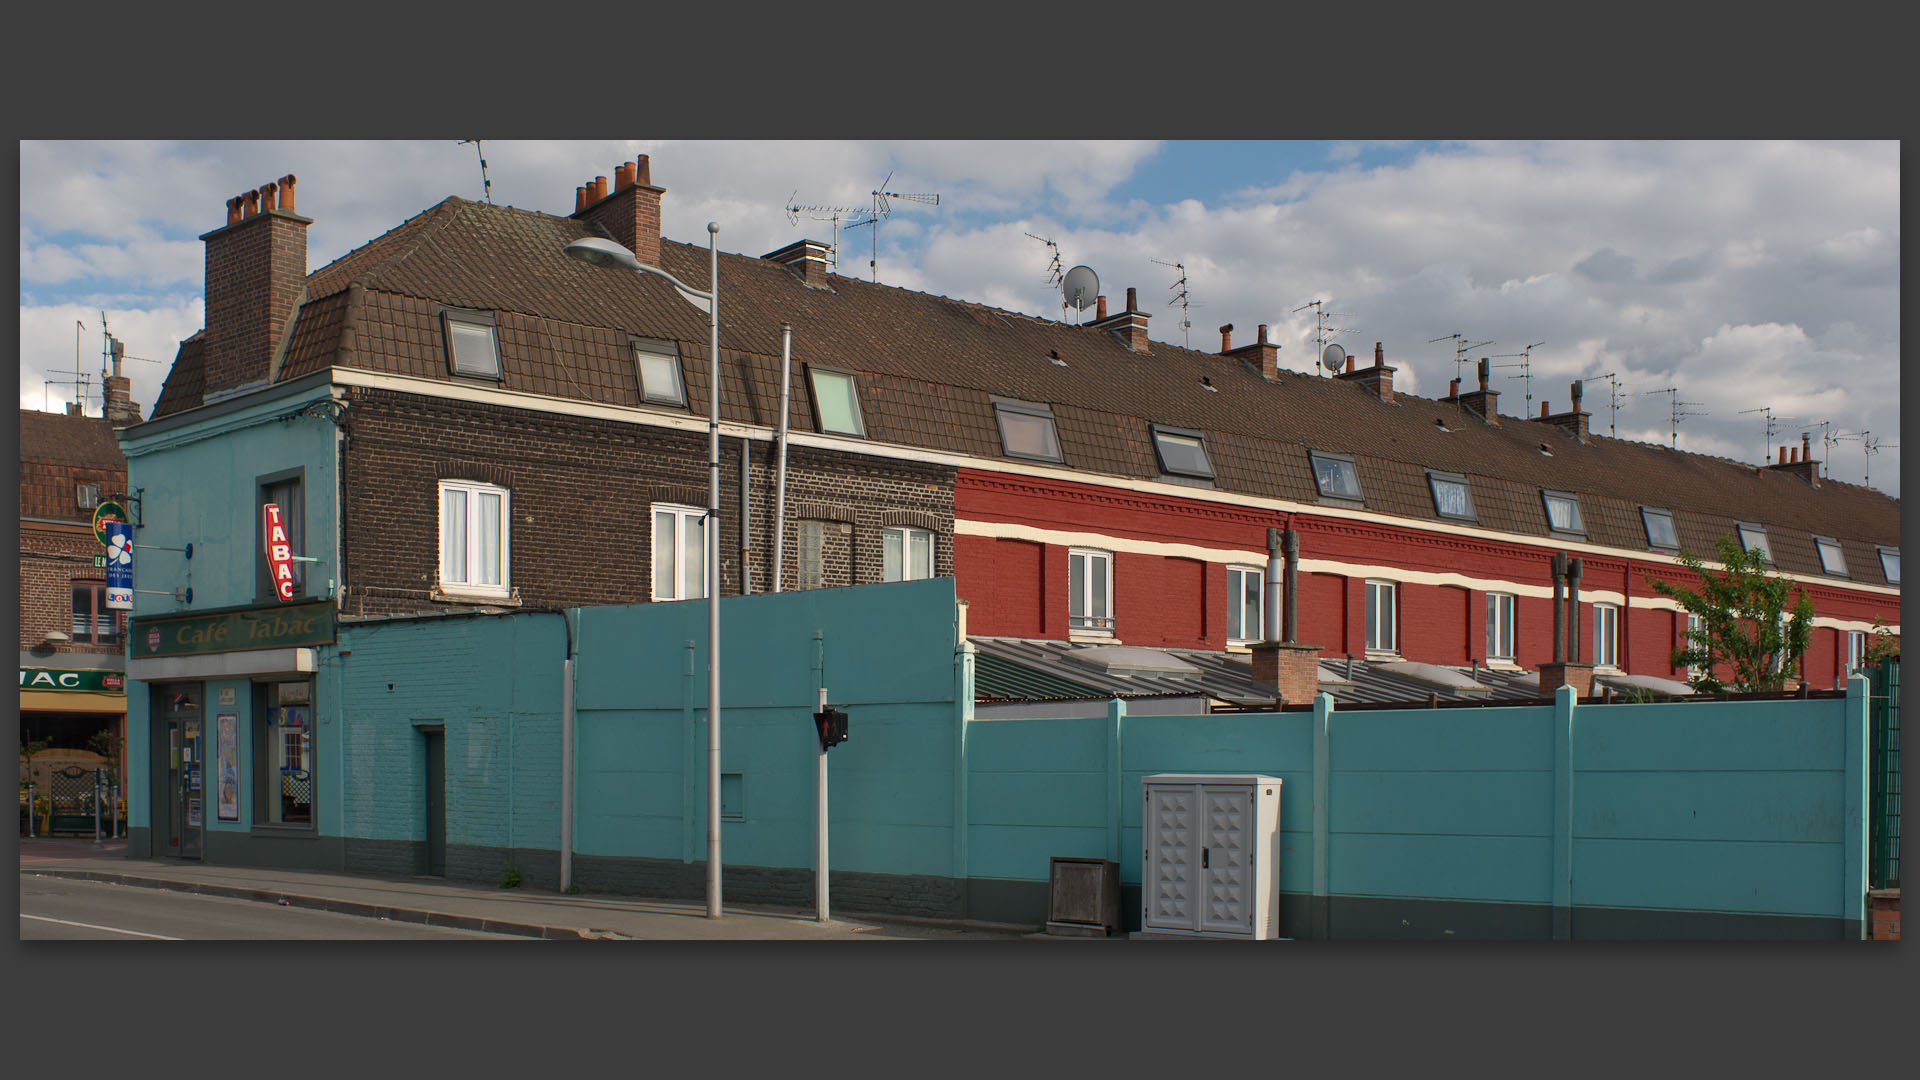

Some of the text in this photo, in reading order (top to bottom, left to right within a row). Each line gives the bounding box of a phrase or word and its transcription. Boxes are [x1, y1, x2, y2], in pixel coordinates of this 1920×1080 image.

[269, 507, 293, 598] TABAC
[176, 622, 228, 645] Café
[248, 617, 316, 639] Tabac
